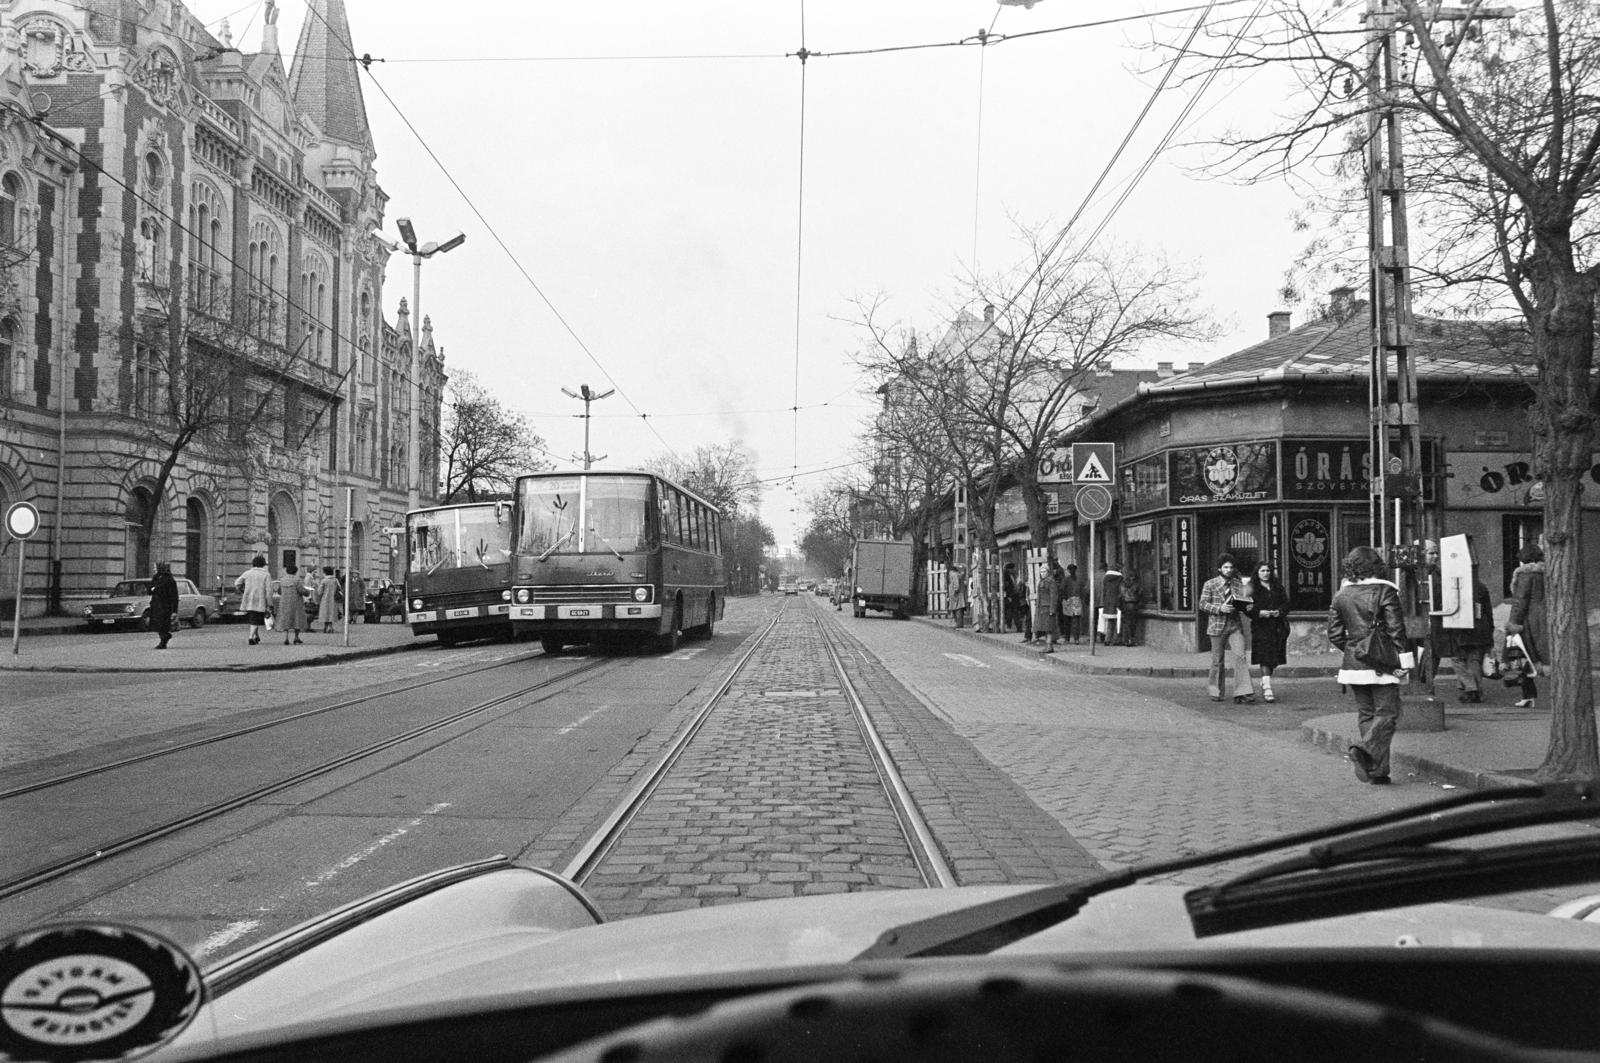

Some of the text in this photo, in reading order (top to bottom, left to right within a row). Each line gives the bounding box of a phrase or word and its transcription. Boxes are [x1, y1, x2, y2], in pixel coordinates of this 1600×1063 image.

[1295, 446, 1396, 480] ÓRÁS
[1295, 482, 1368, 490] SZÖVETK
[1179, 494, 1208, 503] ÓRÁS
[1298, 569, 1324, 585] ÓRA
